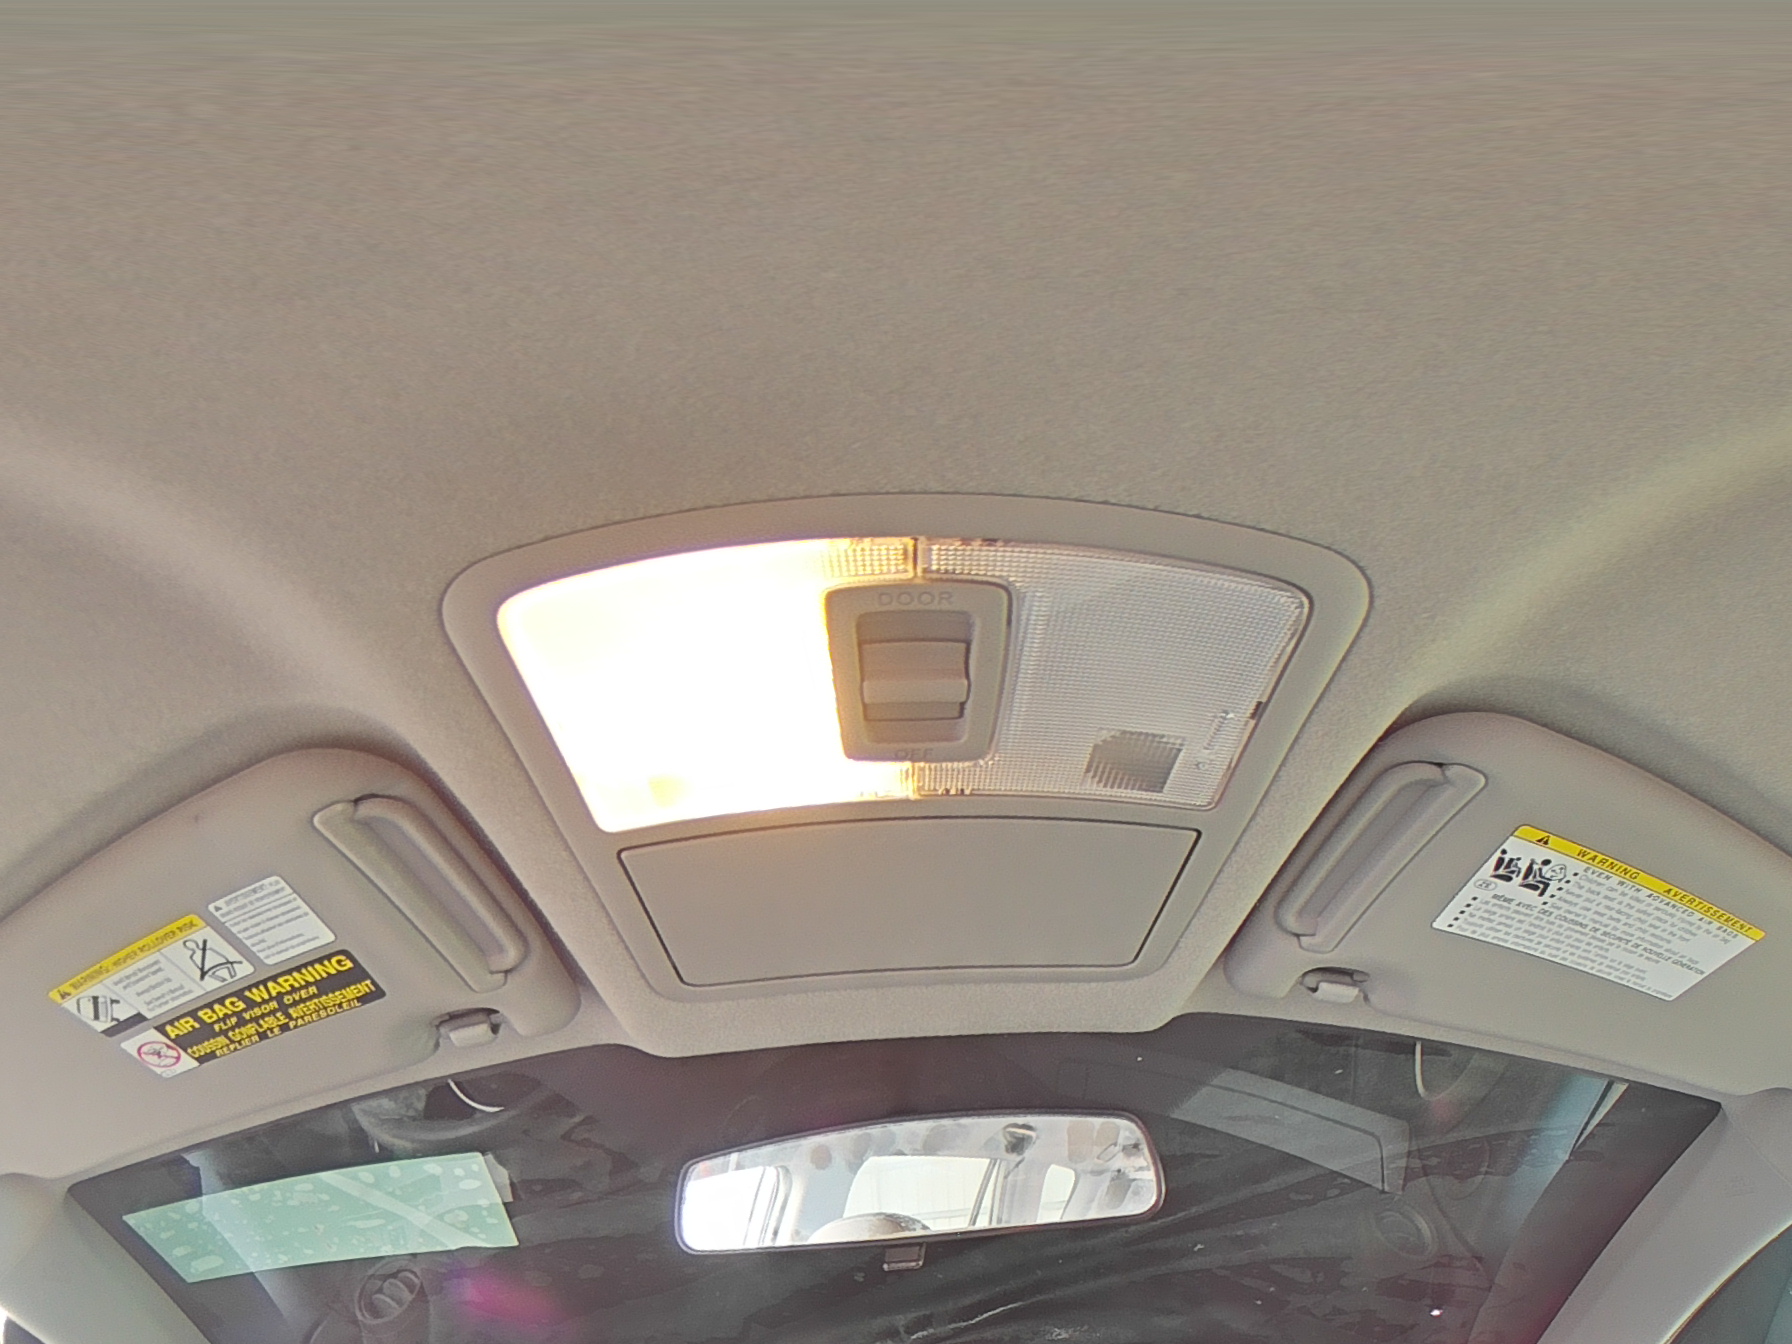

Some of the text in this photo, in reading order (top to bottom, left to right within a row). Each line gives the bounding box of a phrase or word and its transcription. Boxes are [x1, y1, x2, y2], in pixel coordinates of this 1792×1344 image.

[878, 591, 953, 606] DOOR
[895, 748, 935, 760] OFF
[1576, 849, 1641, 880] WARNING
[1663, 887, 1753, 934] AVERTISSEMENT
[1583, 866, 1613, 881] EVEN
[1616, 880, 1643, 893] WITH
[1645, 893, 1696, 918] ADVANCED
[165, 955, 354, 1039] AIR BAG WARNING
[187, 980, 376, 1059] COUSSIN GONFLABLE AVERTISSEMENT
[213, 986, 318, 1033] FLIP VISOR OVER
[215, 1036, 260, 1057] REPLIER
[267, 1026, 282, 1038] LE
